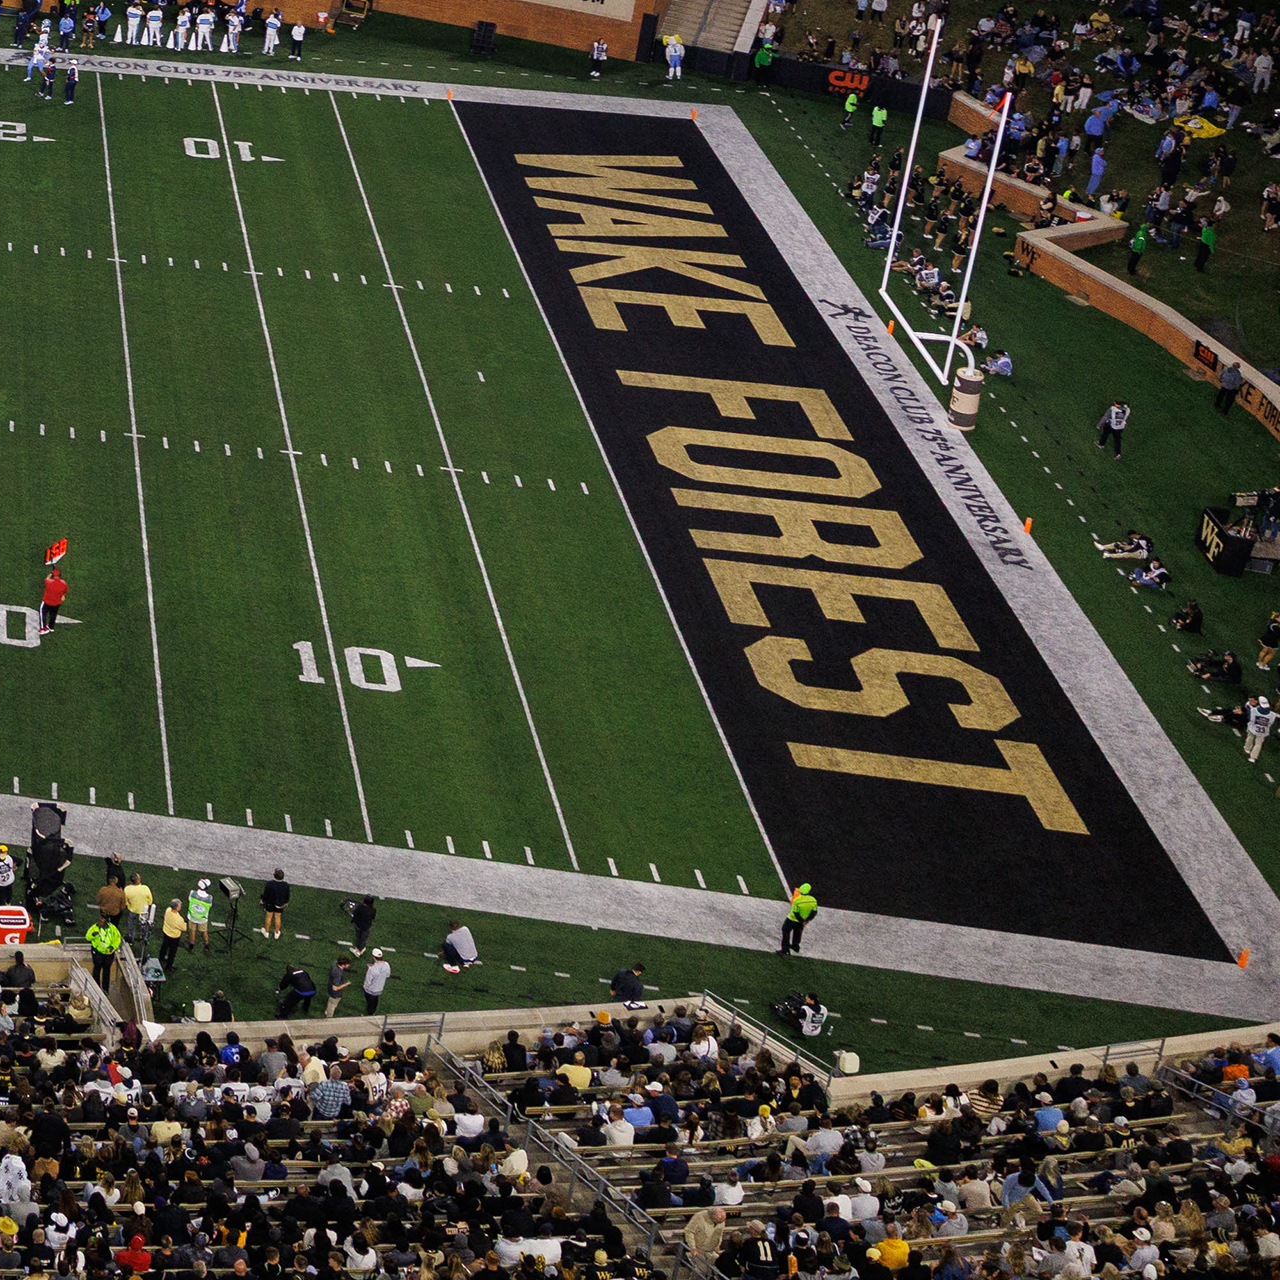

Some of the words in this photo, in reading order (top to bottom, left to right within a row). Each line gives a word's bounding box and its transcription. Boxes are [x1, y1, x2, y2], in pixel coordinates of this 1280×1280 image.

[155, 63, 216, 77] CLUB
[220, 69, 256, 79] 75th
[256, 72, 421, 93] ANNIVERSARY
[828, 70, 870, 91] CW
[183, 136, 256, 161] 10
[514, 153, 797, 348] WAKE
[1020, 239, 1041, 266] WF
[846, 323, 907, 385] DEACON
[891, 386, 935, 430] CLUB
[916, 427, 956, 454] 75th
[929, 449, 1035, 572] ANNIVERSARY
[1200, 513, 1224, 562] WF
[616, 368, 1091, 835] FOREST
[292, 641, 402, 694] 10
[3, 933, 21, 945] G
[756, 1239, 773, 1262] 11
